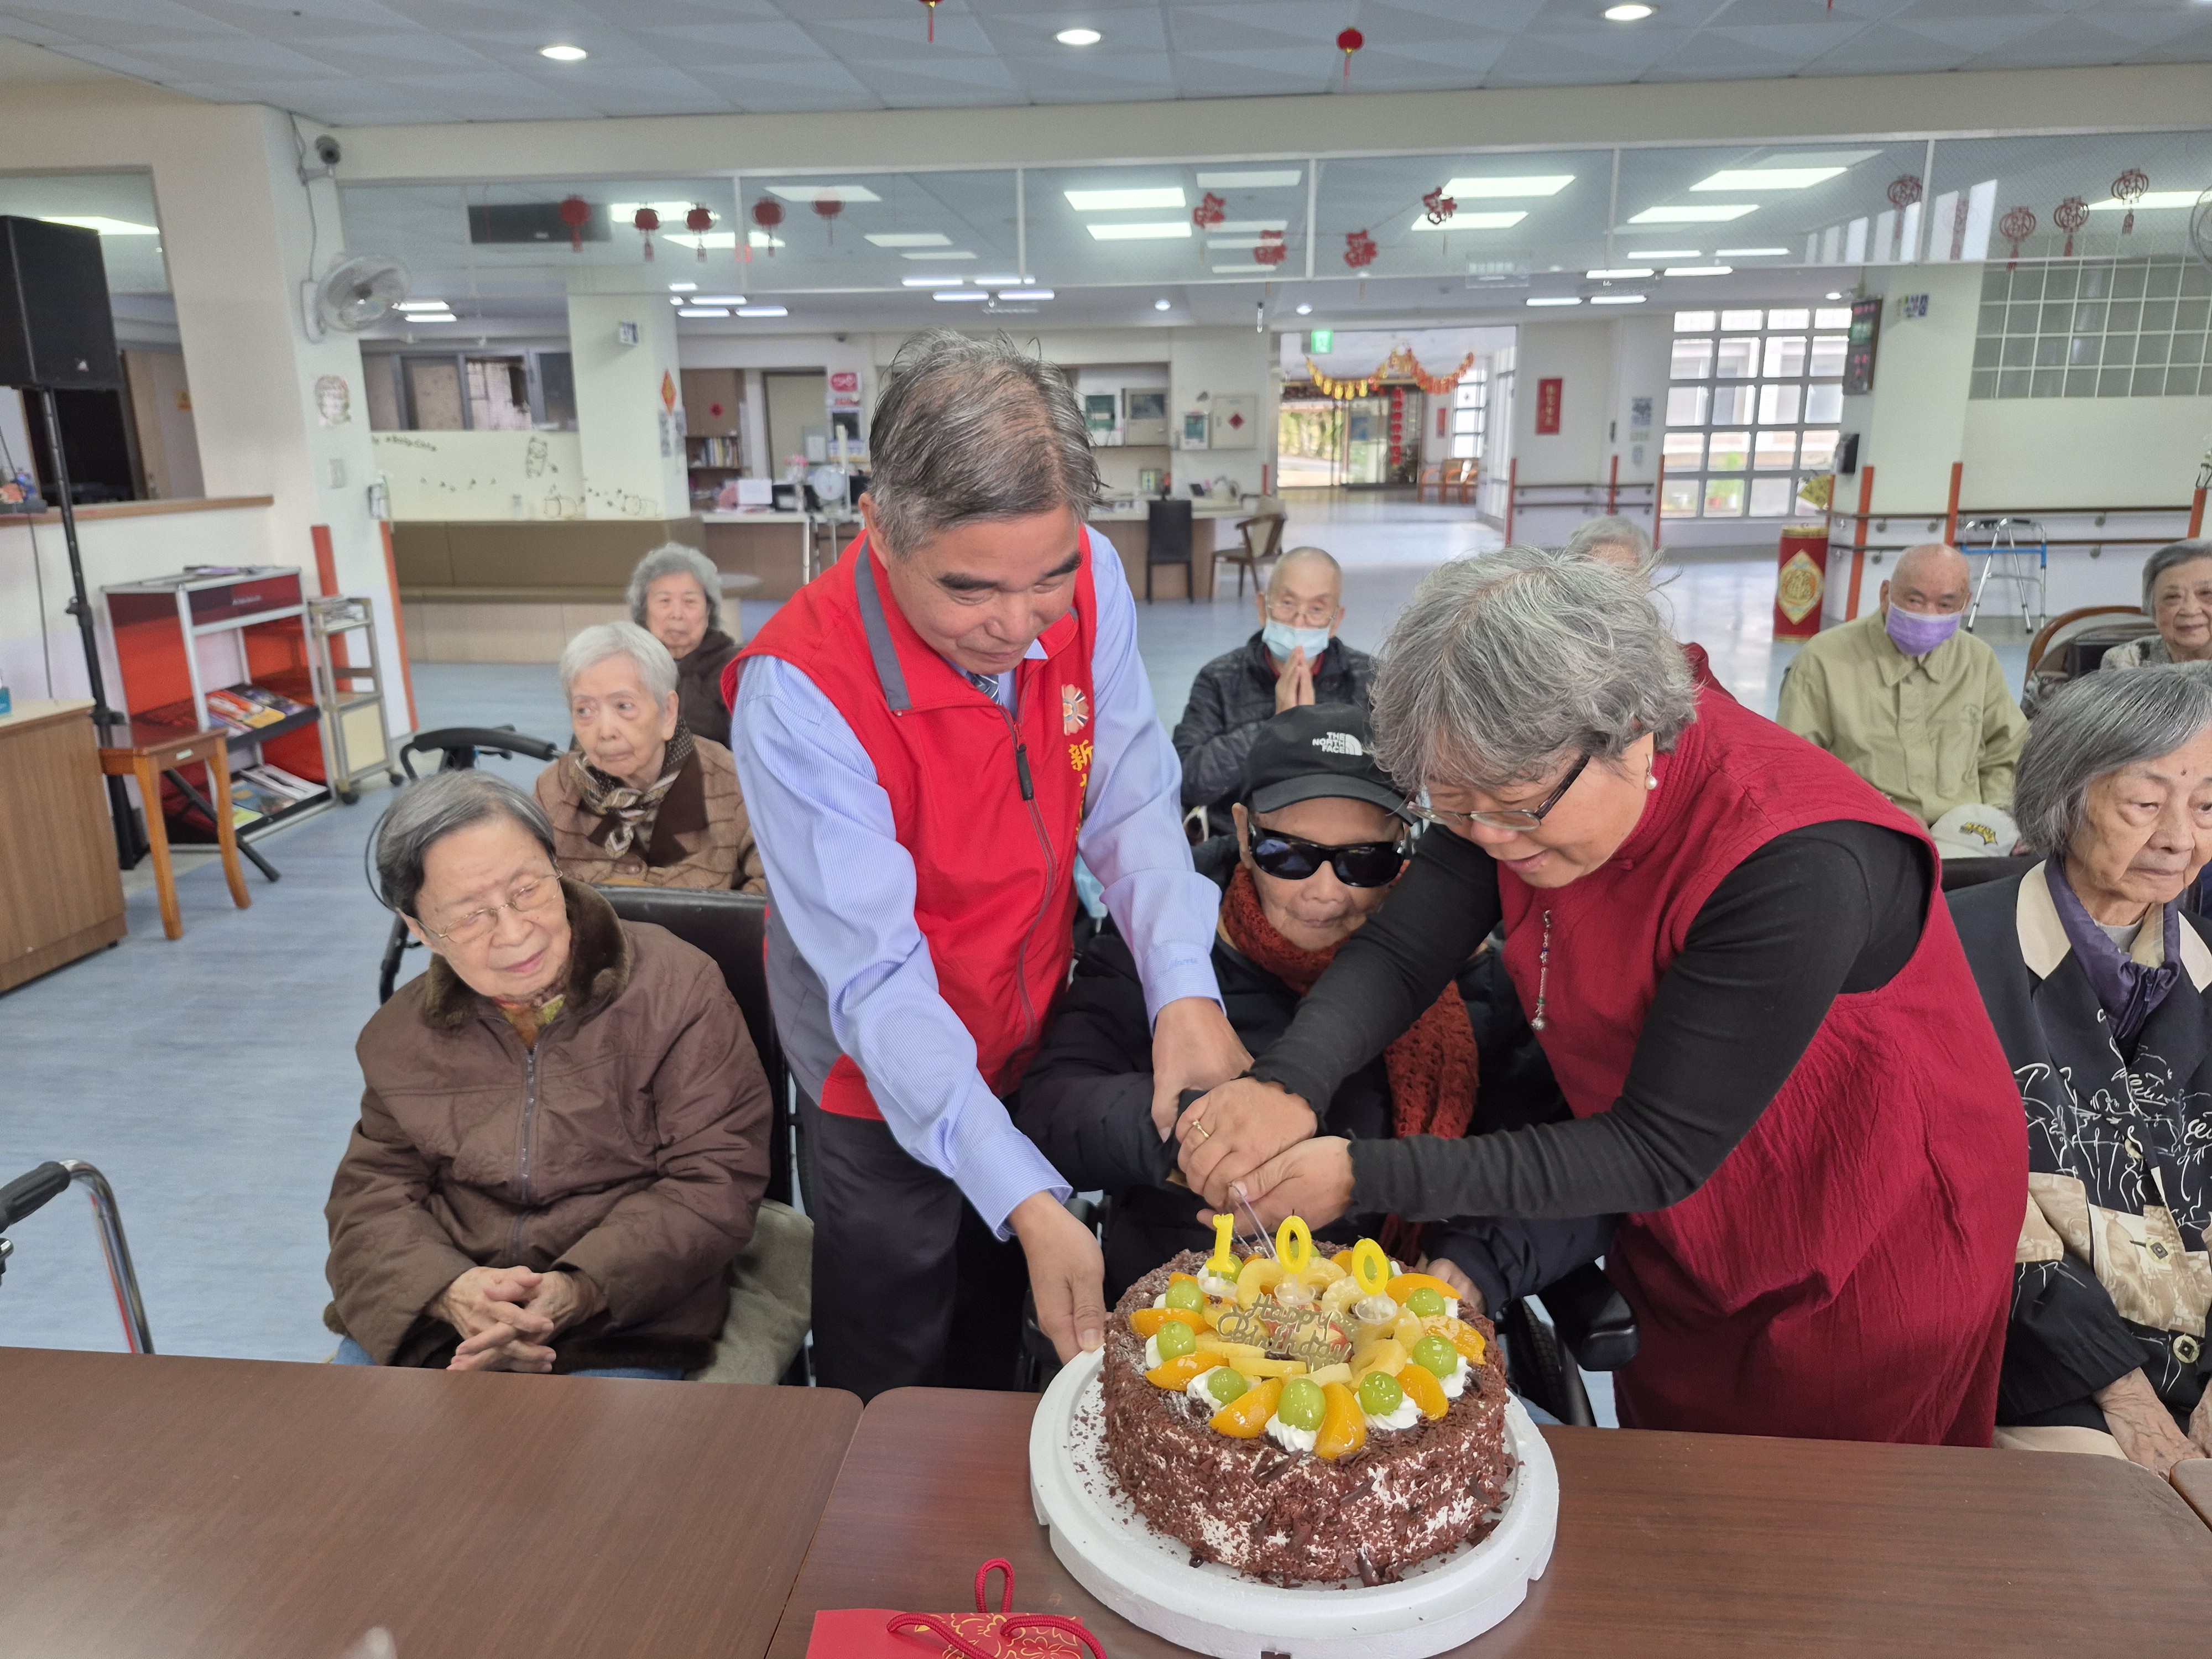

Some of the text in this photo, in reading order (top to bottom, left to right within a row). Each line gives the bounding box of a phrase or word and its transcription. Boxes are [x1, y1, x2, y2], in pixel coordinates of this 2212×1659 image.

[1312, 738, 1345, 747] NORTH
[1322, 745, 1345, 754] FACE
[1326, 732, 1345, 740] THE
[1206, 1213, 1389, 1296] 100
[1243, 1292, 1337, 1343] Happy
[1216, 1304, 1353, 1373] Birthday
